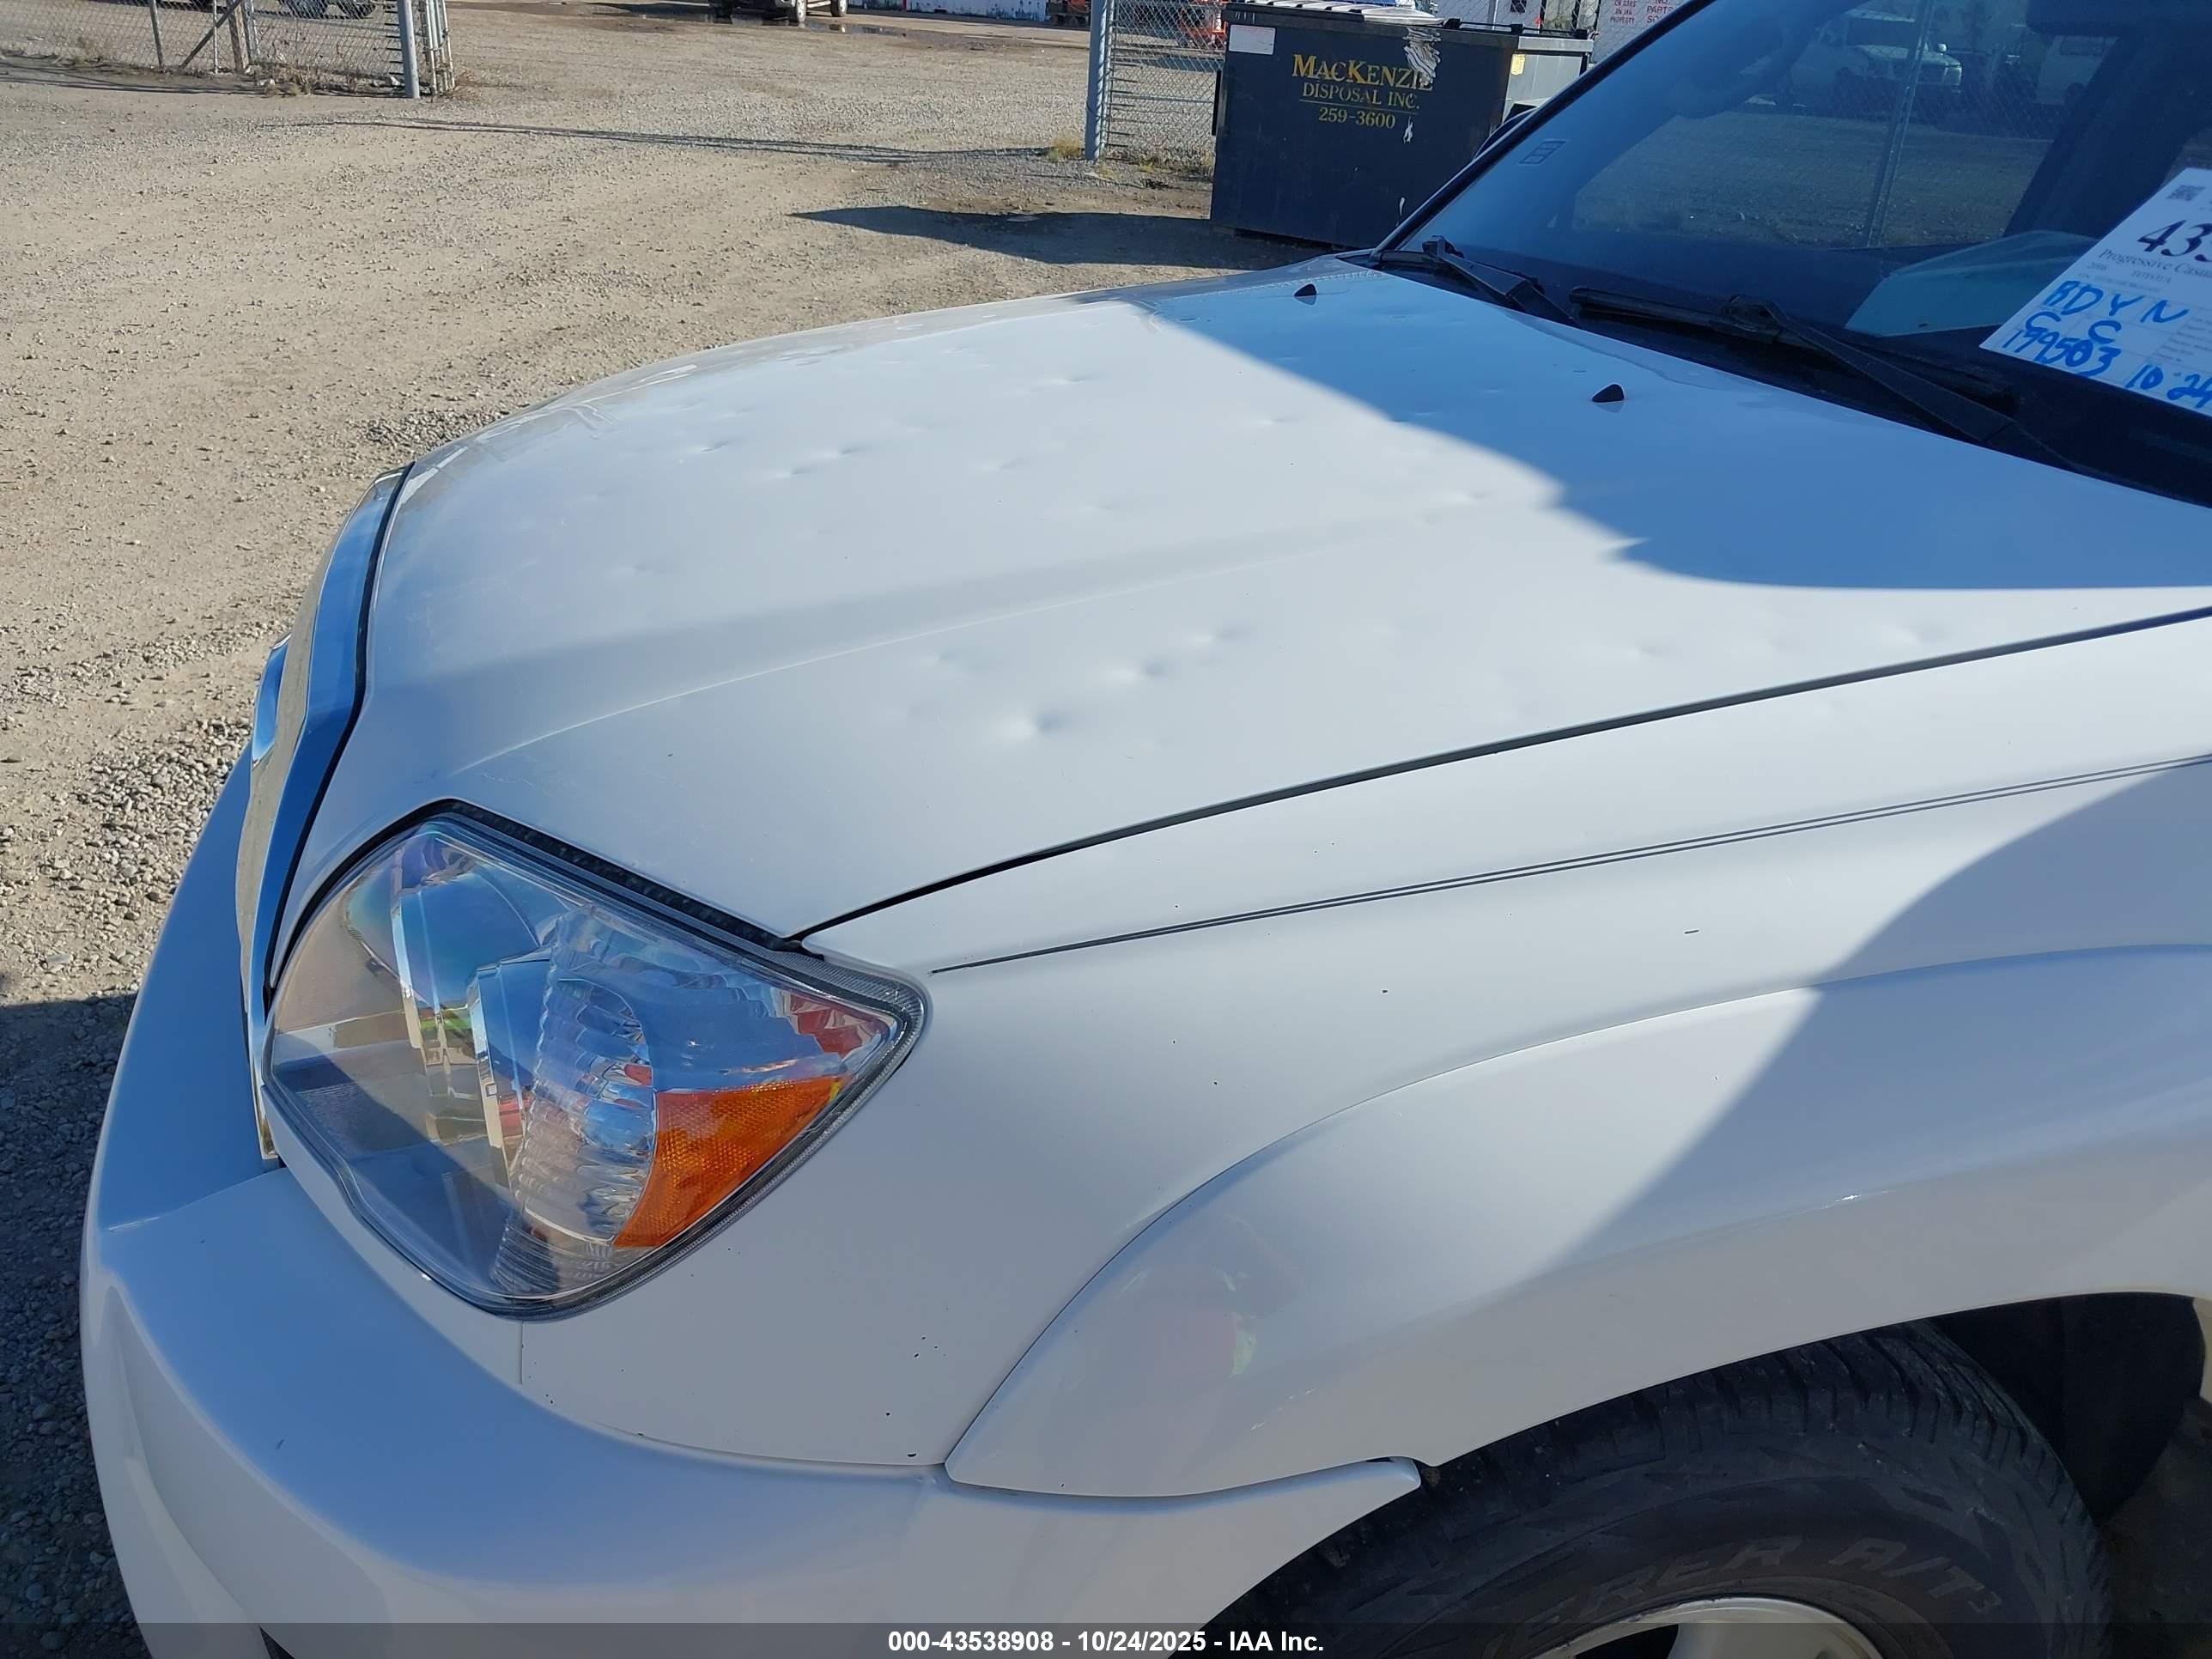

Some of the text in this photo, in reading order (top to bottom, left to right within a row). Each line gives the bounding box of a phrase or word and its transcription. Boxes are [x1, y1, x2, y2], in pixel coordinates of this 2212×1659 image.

[1646, 5, 1674, 15] PARTS
[1302, 82, 1420, 110] DISPOSAL INC.
[1318, 106, 1397, 129] 259-3600
[2099, 249, 2212, 279] Progressive Casu
